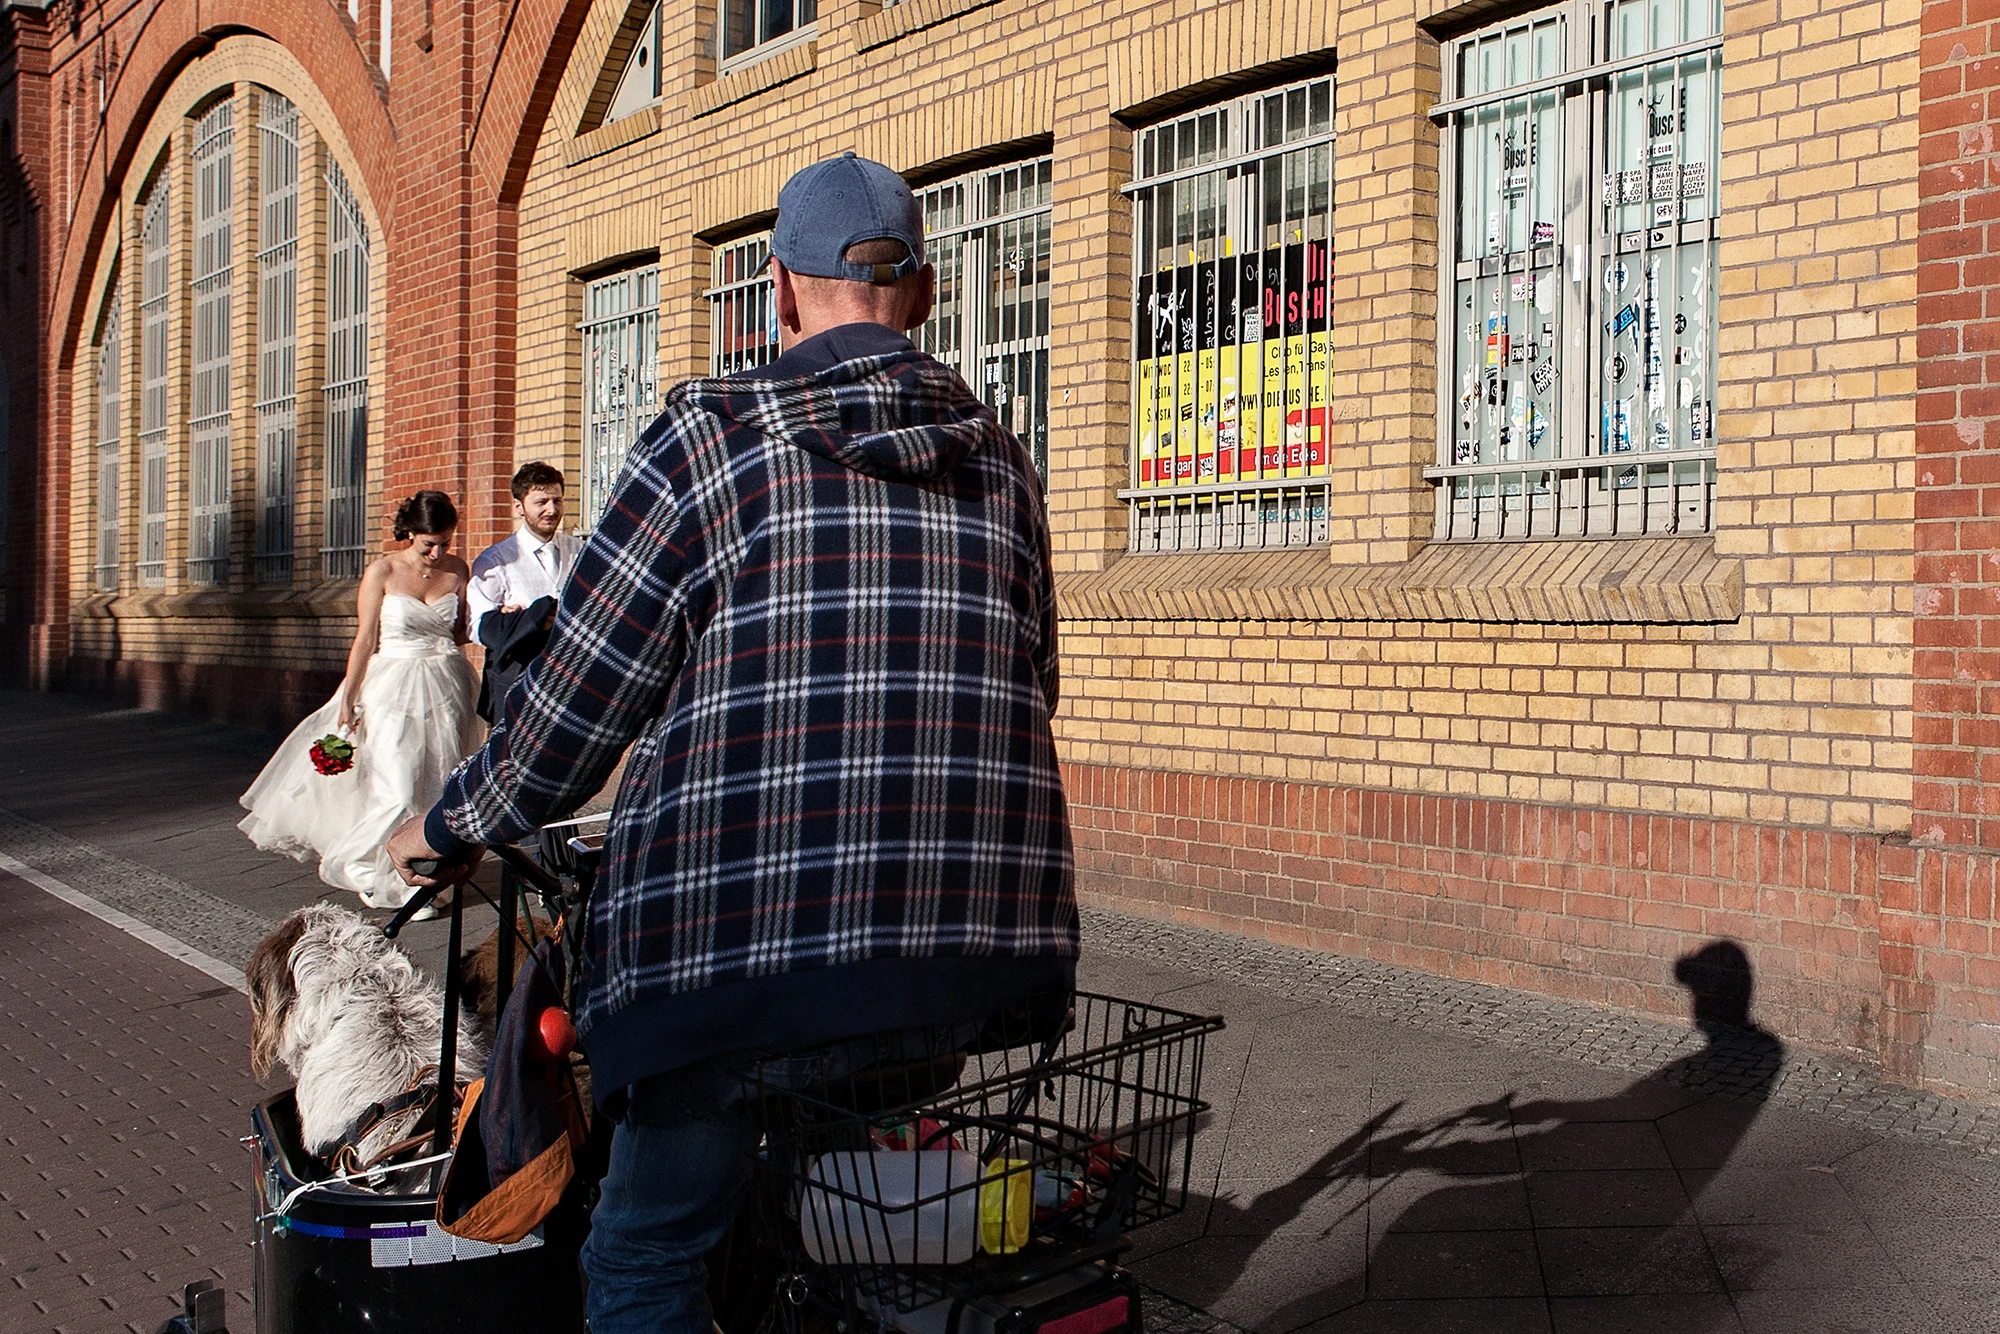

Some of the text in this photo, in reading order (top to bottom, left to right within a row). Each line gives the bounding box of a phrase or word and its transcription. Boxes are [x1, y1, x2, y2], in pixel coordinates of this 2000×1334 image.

[1649, 112, 1685, 138] BUSCE
[1504, 146, 1536, 170] BUSCE
[1308, 243, 1334, 283] DI
[1265, 286, 1334, 327] BUSCH
[1272, 344, 1292, 359] Clb
[1295, 341, 1305, 355] fü
[1264, 365, 1299, 377] Lesen,
[1164, 459, 1196, 475] Egan
[1273, 450, 1288, 465] de
